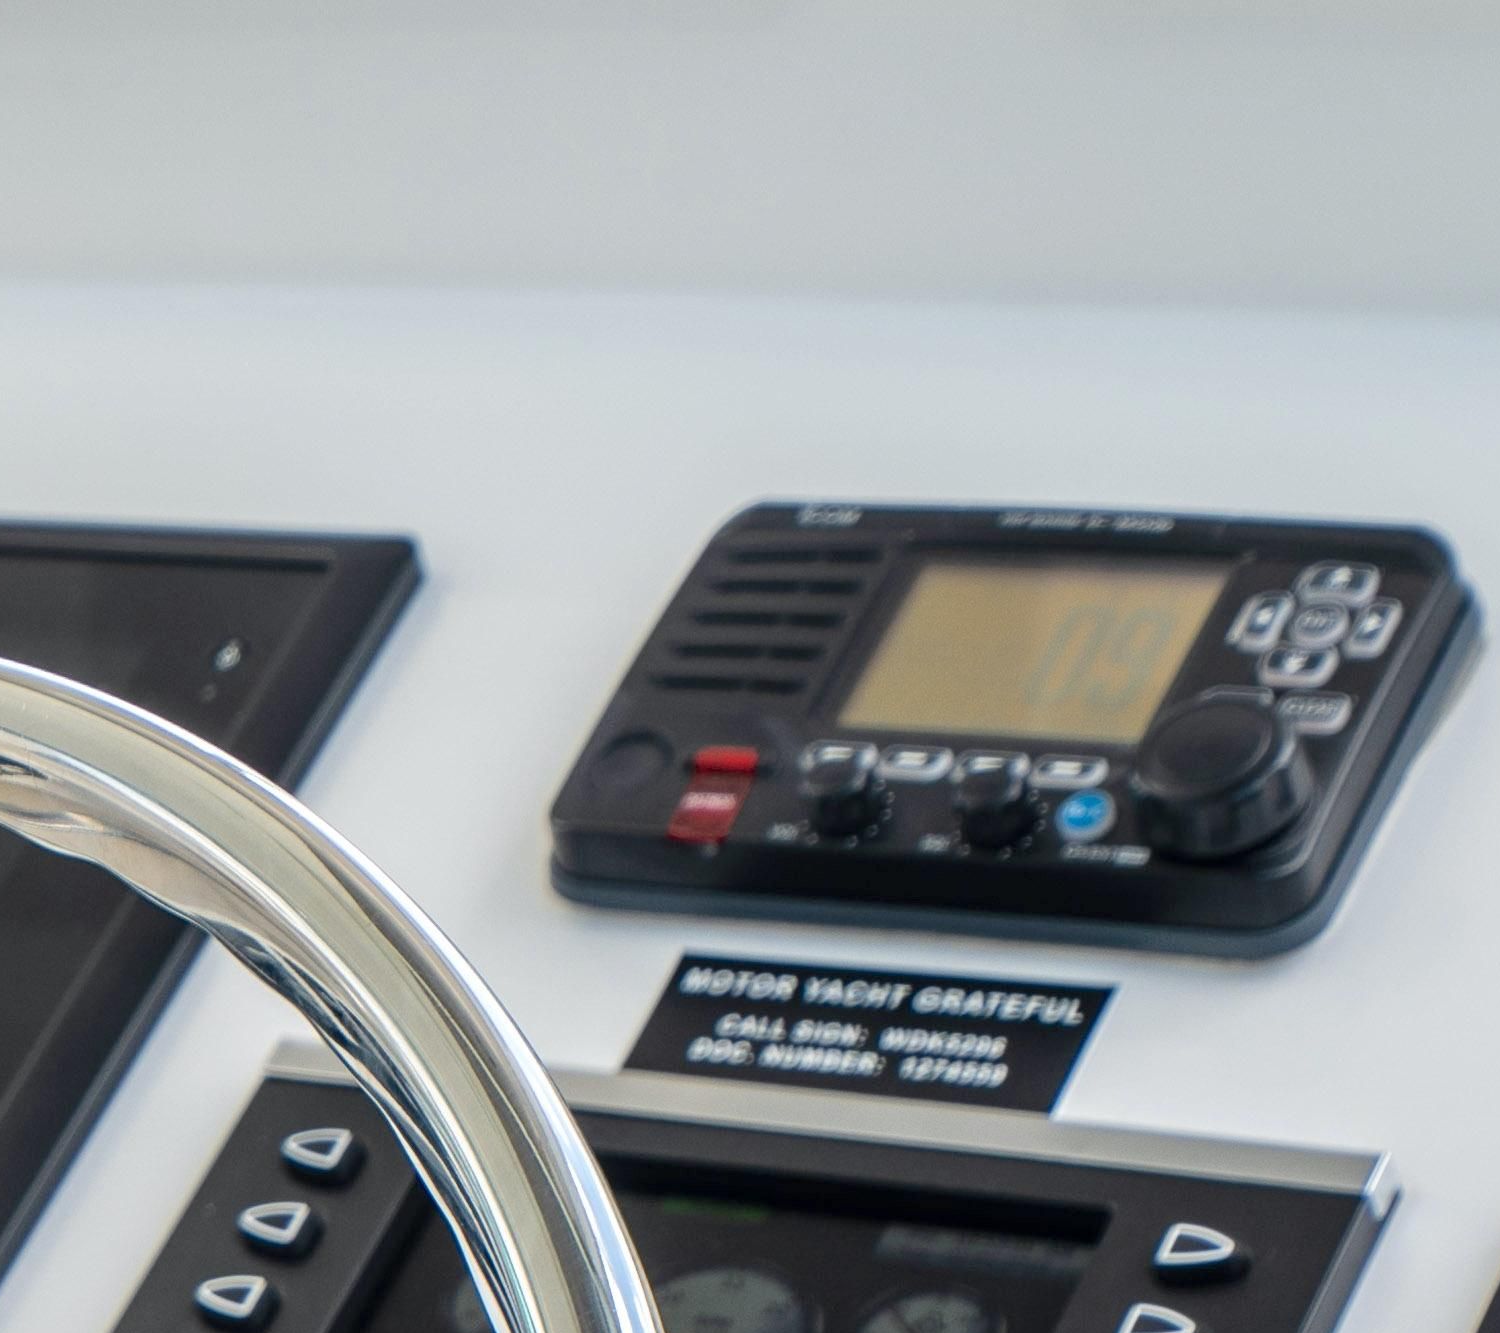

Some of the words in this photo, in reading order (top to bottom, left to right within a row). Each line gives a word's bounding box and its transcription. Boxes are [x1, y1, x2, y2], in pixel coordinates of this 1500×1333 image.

[679, 965, 798, 1001] MOTOR
[802, 975, 912, 1011] YACHT
[911, 985, 1085, 1027] GRATEFUL
[714, 1012, 787, 1041] CALL
[757, 1042, 887, 1078] NUMBER:
